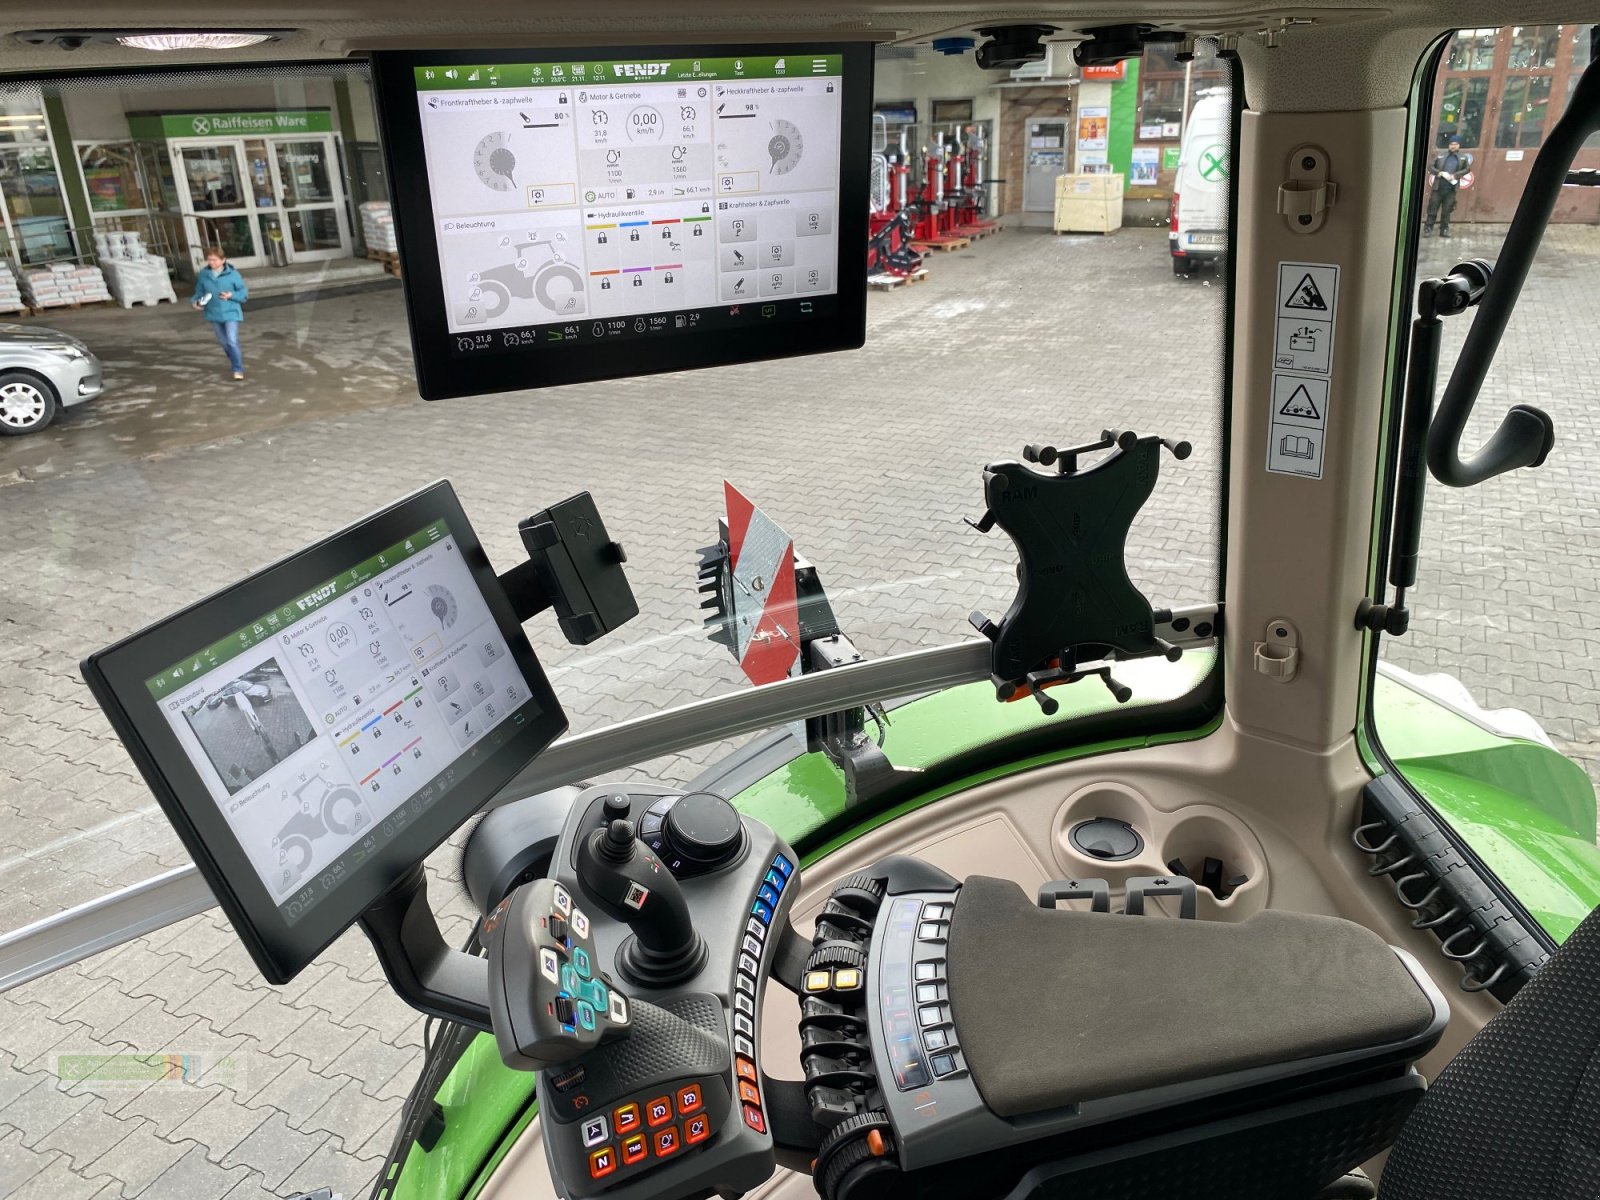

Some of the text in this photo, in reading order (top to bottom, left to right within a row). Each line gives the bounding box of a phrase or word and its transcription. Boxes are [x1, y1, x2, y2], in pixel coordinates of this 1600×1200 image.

[612, 62, 671, 77] FENDT
[726, 86, 769, 95] Heckkraftheber
[440, 97, 492, 107] Frontkraftheber
[212, 115, 308, 130] Raiffeisen Ware
[632, 113, 656, 126] 0,00
[763, 198, 790, 207] Zapfwelle
[597, 209, 644, 219] Hydraulikventile
[455, 220, 495, 230] Beleuchtung
[607, 320, 625, 329] 1100
[649, 316, 666, 325] 1560
[520, 330, 536, 338] 66,1
[564, 325, 579, 334] 66,1
[475, 334, 492, 343] 31,8
[1002, 486, 1038, 503] RAM
[295, 580, 340, 611] FENDT
[328, 624, 350, 644] 0,00
[179, 686, 205, 705] Standard
[238, 780, 271, 807] Beleuchtung
[628, 1144, 642, 1153] TMS
[598, 1156, 608, 1168] N
